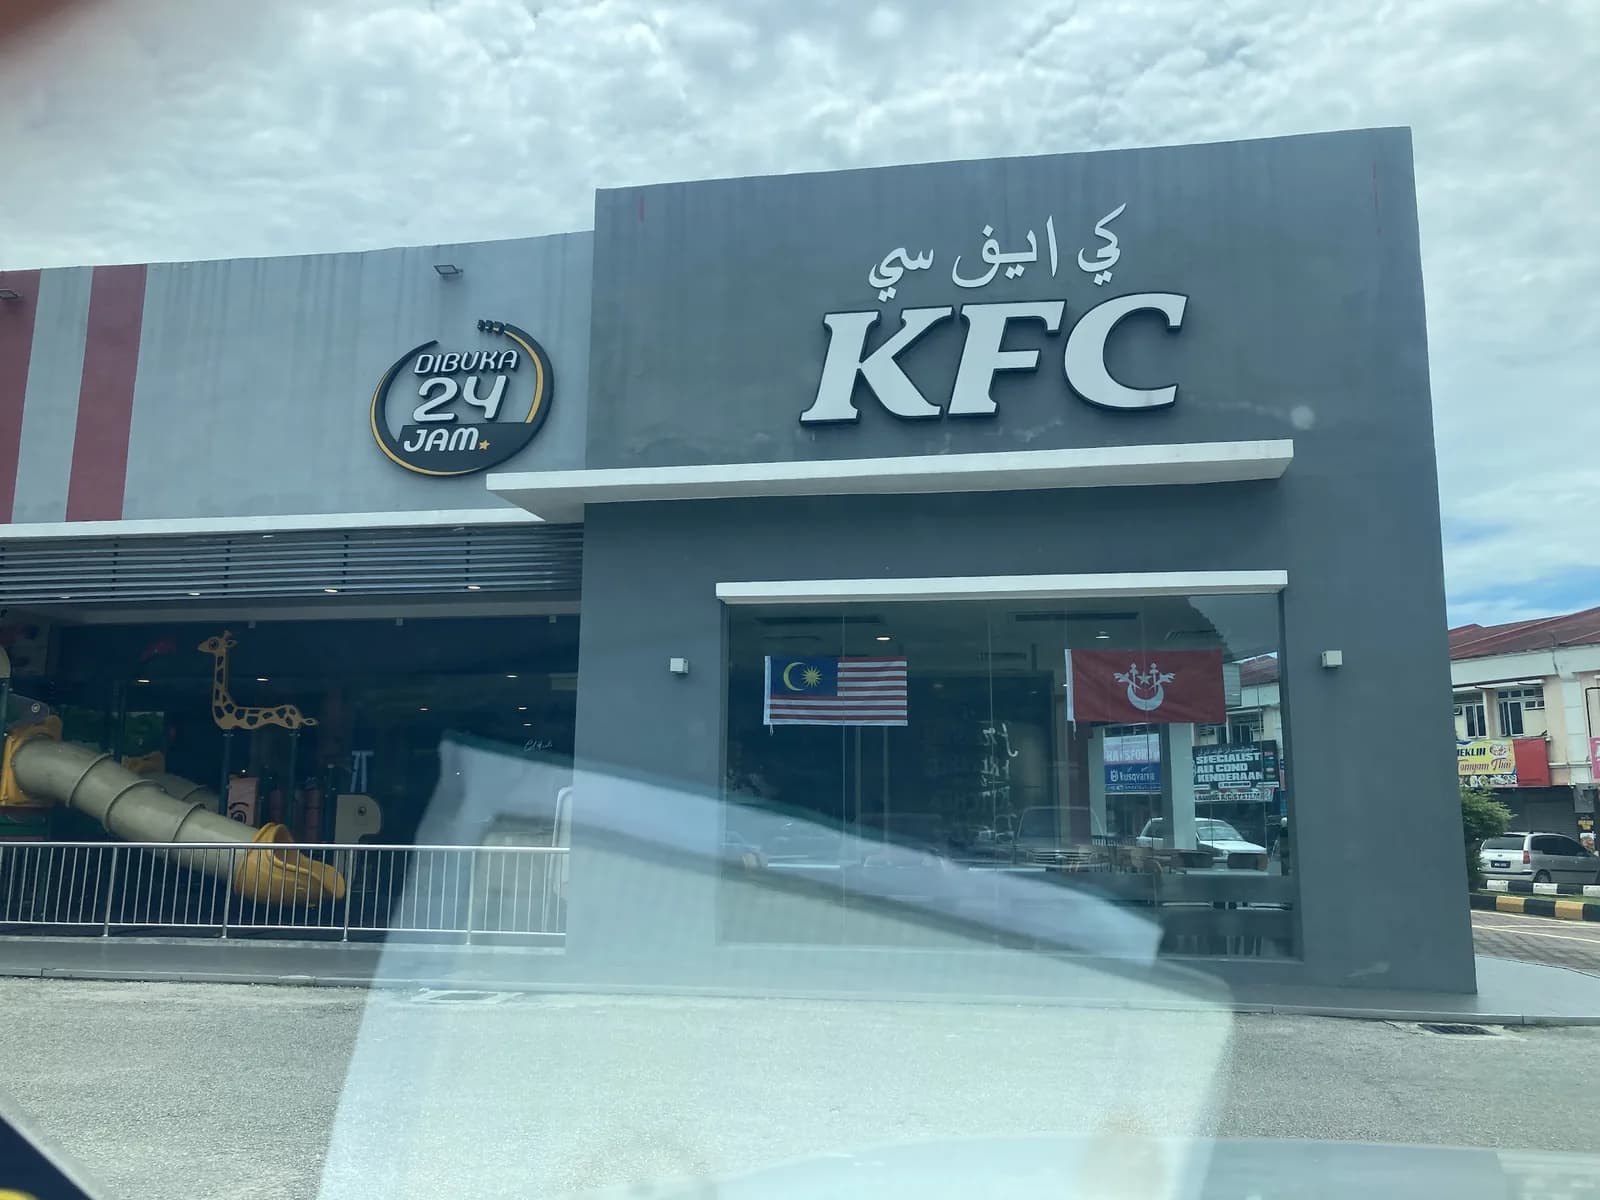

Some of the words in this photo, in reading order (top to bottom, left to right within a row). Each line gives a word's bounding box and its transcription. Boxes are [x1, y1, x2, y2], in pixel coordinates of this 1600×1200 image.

[413, 349, 520, 375] DIBUKA
[799, 292, 1189, 422] KFC
[412, 375, 508, 422] 24
[403, 427, 479, 452] JAM
[1195, 752, 1262, 764] SPECIALIST
[1491, 757, 1511, 770] Thai
[1197, 764, 1214, 774] AIR
[1215, 763, 1248, 773] COND
[1197, 772, 1263, 782] KENDERAAN
